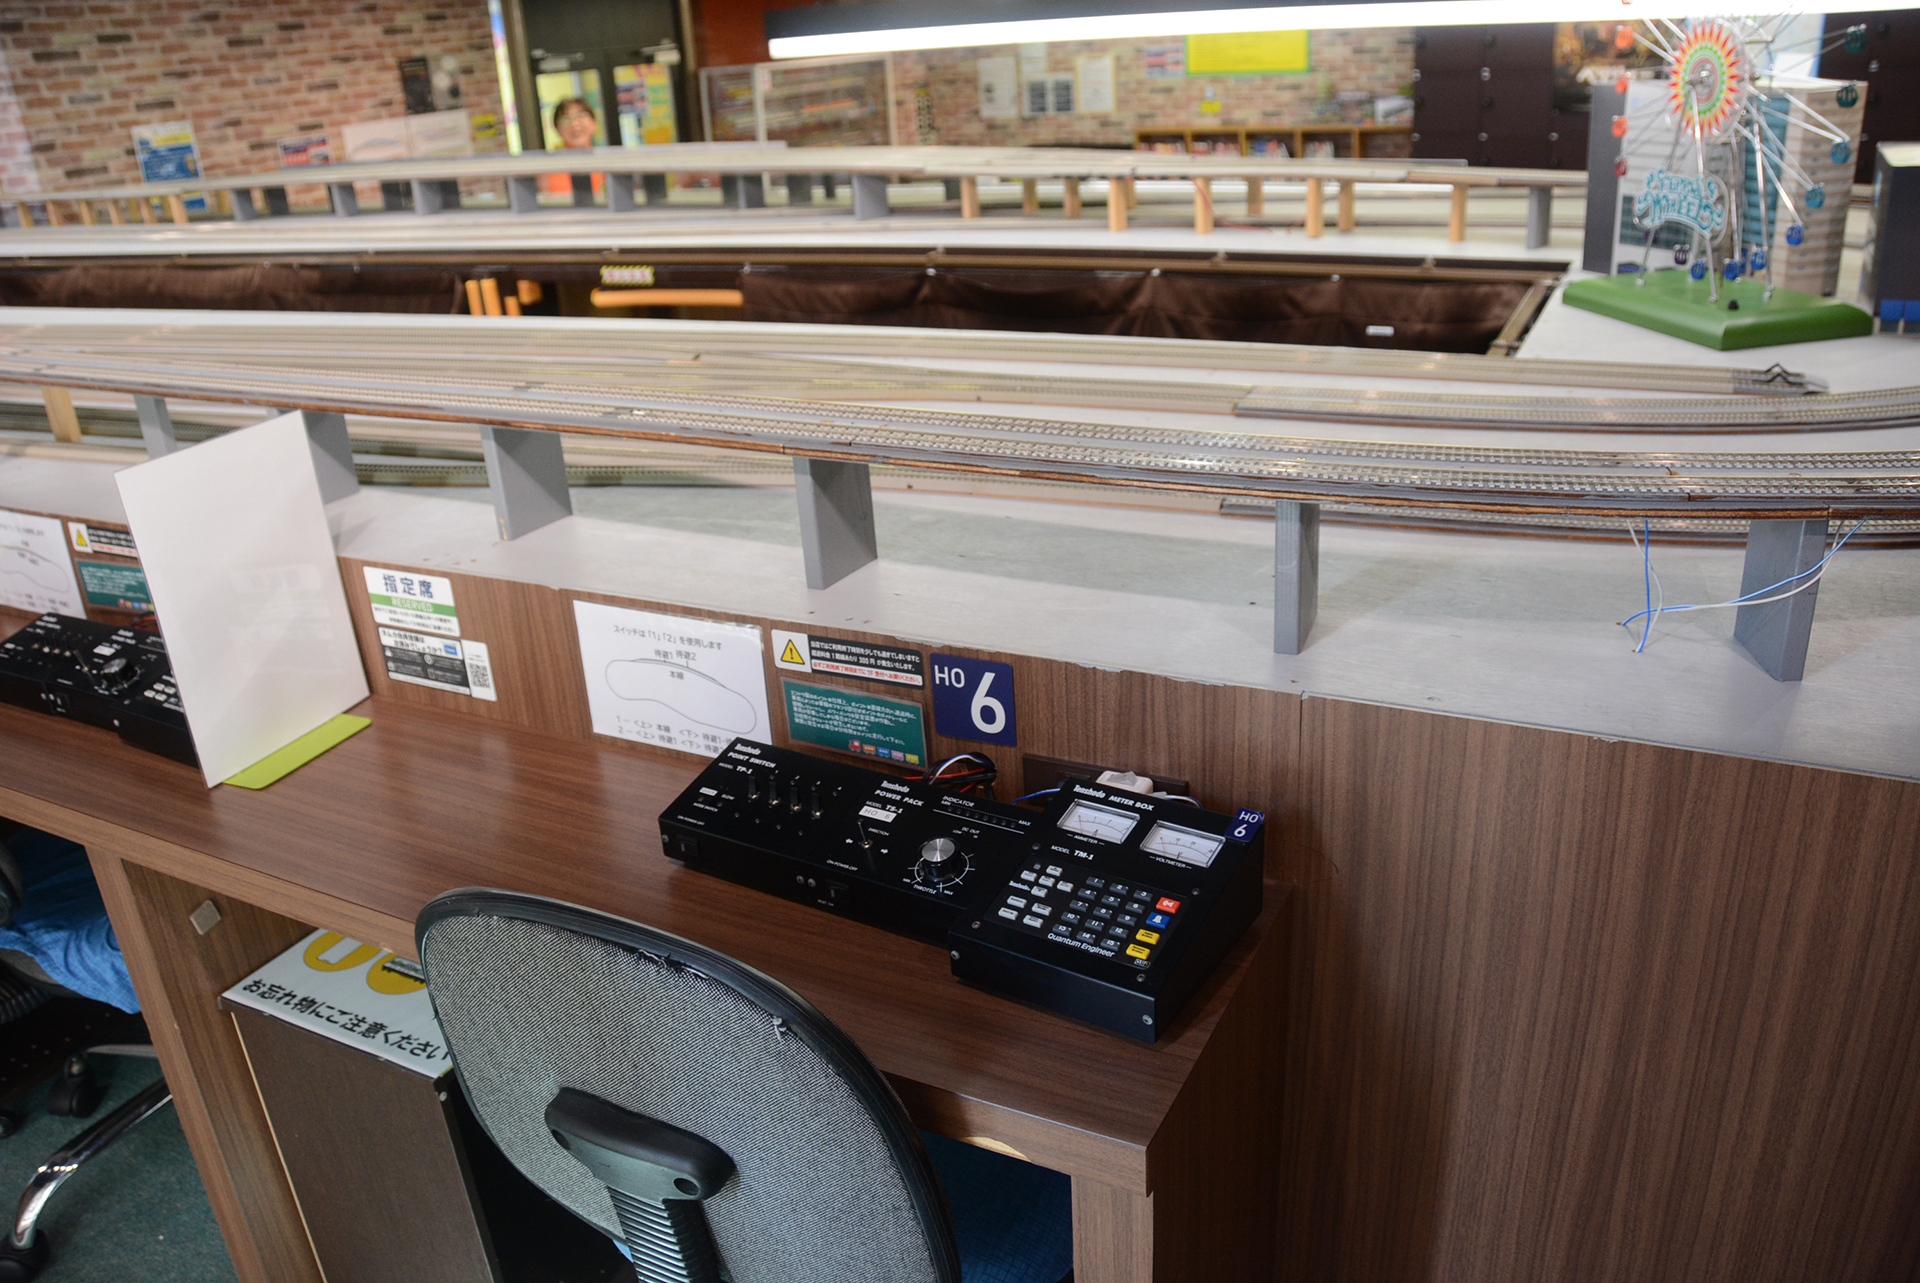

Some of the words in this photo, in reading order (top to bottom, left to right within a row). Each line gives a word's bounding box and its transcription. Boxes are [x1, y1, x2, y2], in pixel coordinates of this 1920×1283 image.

[382, 573, 434, 599] 指定席
[391, 596, 434, 613] RESERVED
[669, 670, 685, 680] 本線
[934, 664, 965, 688] HO
[971, 671, 1006, 734] 6
[727, 752, 749, 761] POINT
[749, 757, 776, 768] SWITCH
[875, 789, 902, 801] POWER
[903, 797, 924, 807] PACK
[942, 795, 976, 808] INDICATOR
[1073, 784, 1106, 799] Tenshodo
[1108, 795, 1135, 807] METER
[1134, 802, 1155, 812] BOX
[866, 800, 882, 809] MODEL
[885, 804, 903, 814] TS-1
[1018, 819, 1032, 827] MAX
[1239, 810, 1259, 823] HO
[868, 827, 890, 836] DIRECTION
[1233, 824, 1248, 837] 6
[1050, 844, 1070, 855] MODEL
[1073, 850, 1095, 861] TM-1
[1155, 857, 1187, 869] VOLTMETER
[913, 884, 937, 895] THROTTLE
[1047, 932, 1082, 948] Quantum
[1081, 942, 1116, 957] Engineer
[242, 979, 450, 1061] お忘れ物にご注意ください
